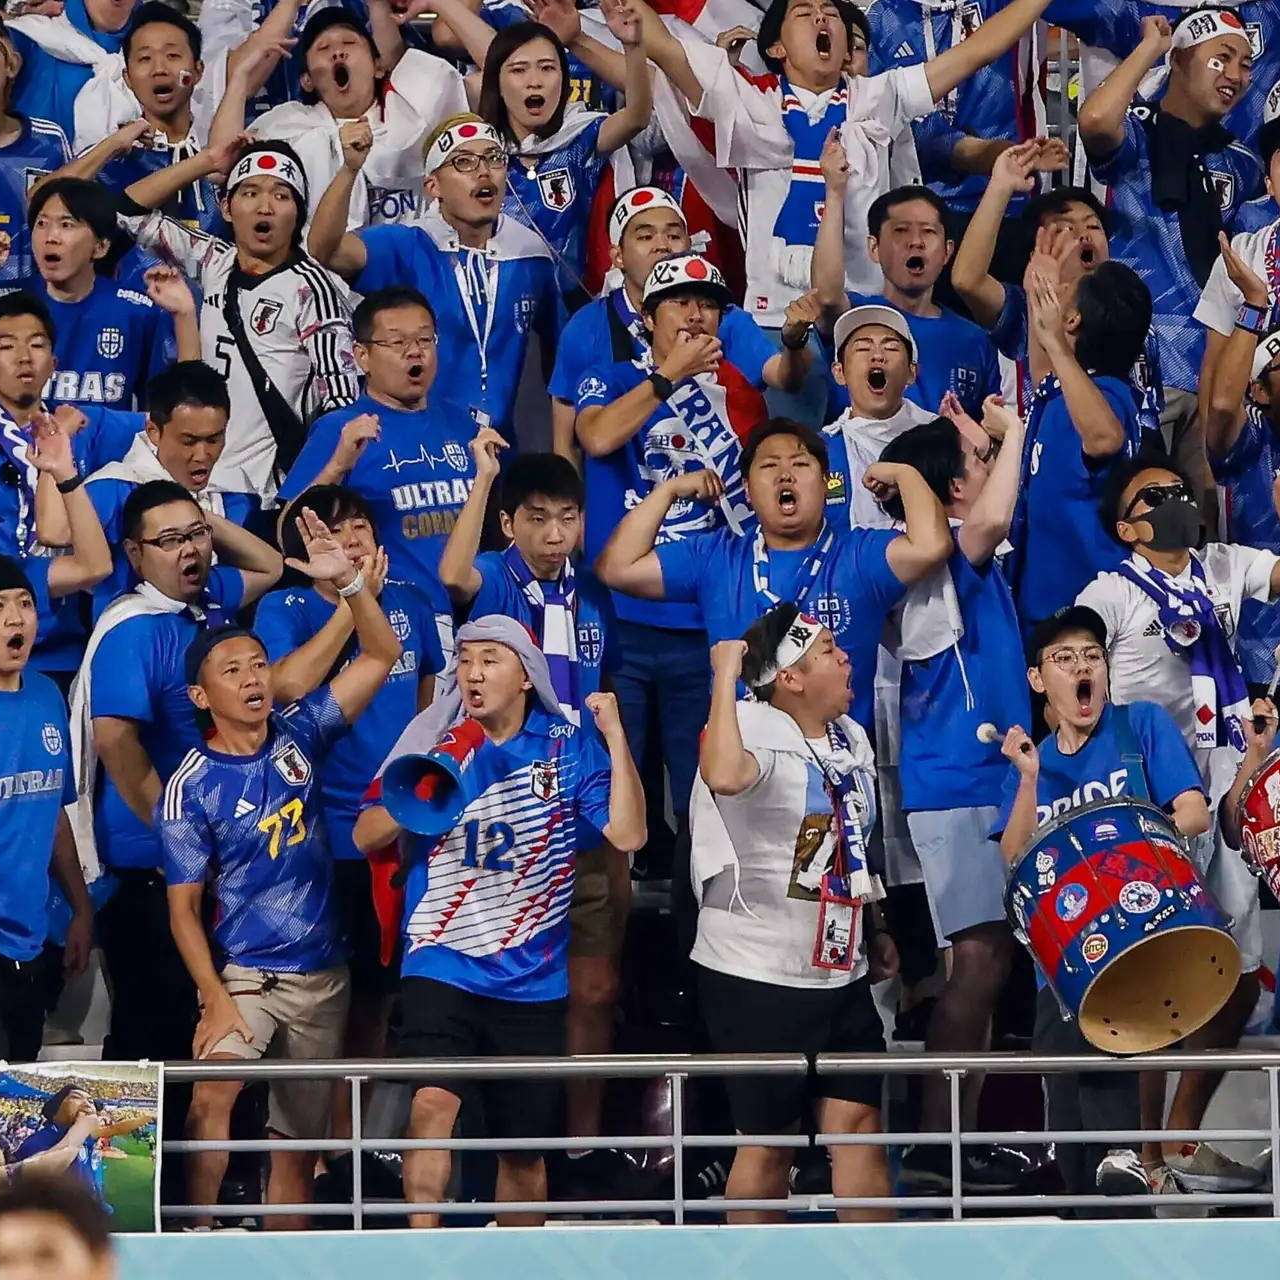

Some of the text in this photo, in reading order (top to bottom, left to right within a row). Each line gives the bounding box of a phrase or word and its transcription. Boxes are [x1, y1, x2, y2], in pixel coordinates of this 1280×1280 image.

[236, 156, 296, 182] 日本
[41, 370, 127, 402] TRAS
[1036, 768, 1128, 827] PRIDE
[257, 797, 307, 860] 73
[460, 817, 516, 872] 12
[1084, 941, 1107, 955] BITCH
